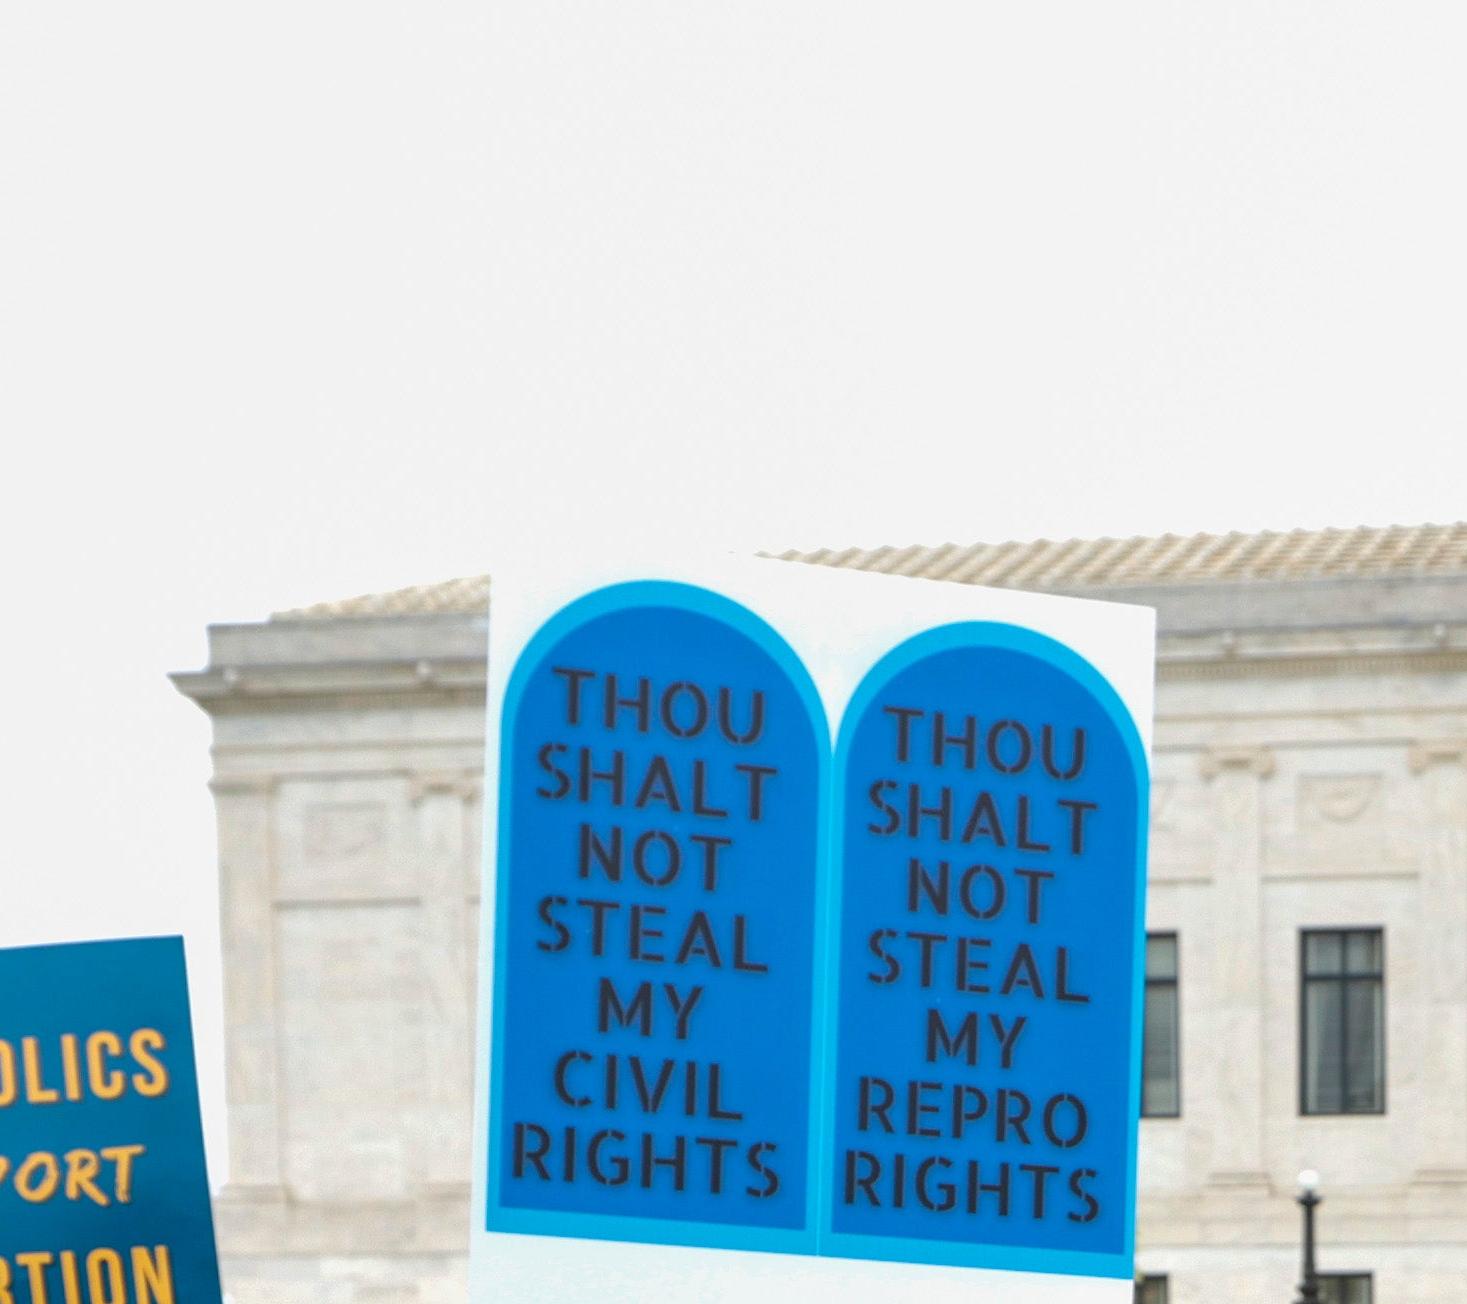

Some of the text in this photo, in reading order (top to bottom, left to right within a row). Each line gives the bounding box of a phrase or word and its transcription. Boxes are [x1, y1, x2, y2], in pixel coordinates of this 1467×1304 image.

[552, 668, 767, 746] THOU
[884, 706, 1087, 781] THOU
[537, 744, 778, 822] SHALT
[867, 780, 1098, 856] SHALT
[577, 823, 732, 892] NOT
[907, 858, 1055, 925] NOT
[537, 895, 769, 975] STEAL
[868, 929, 1089, 1003] STEAL
[596, 977, 705, 1042] MY
[926, 1008, 1027, 1070] MY
[554, 1050, 745, 1122] CIVIL
[858, 1077, 1089, 1149] REPRO
[513, 1123, 780, 1199] RIGHTS
[844, 1150, 1101, 1224] RIGHTS
